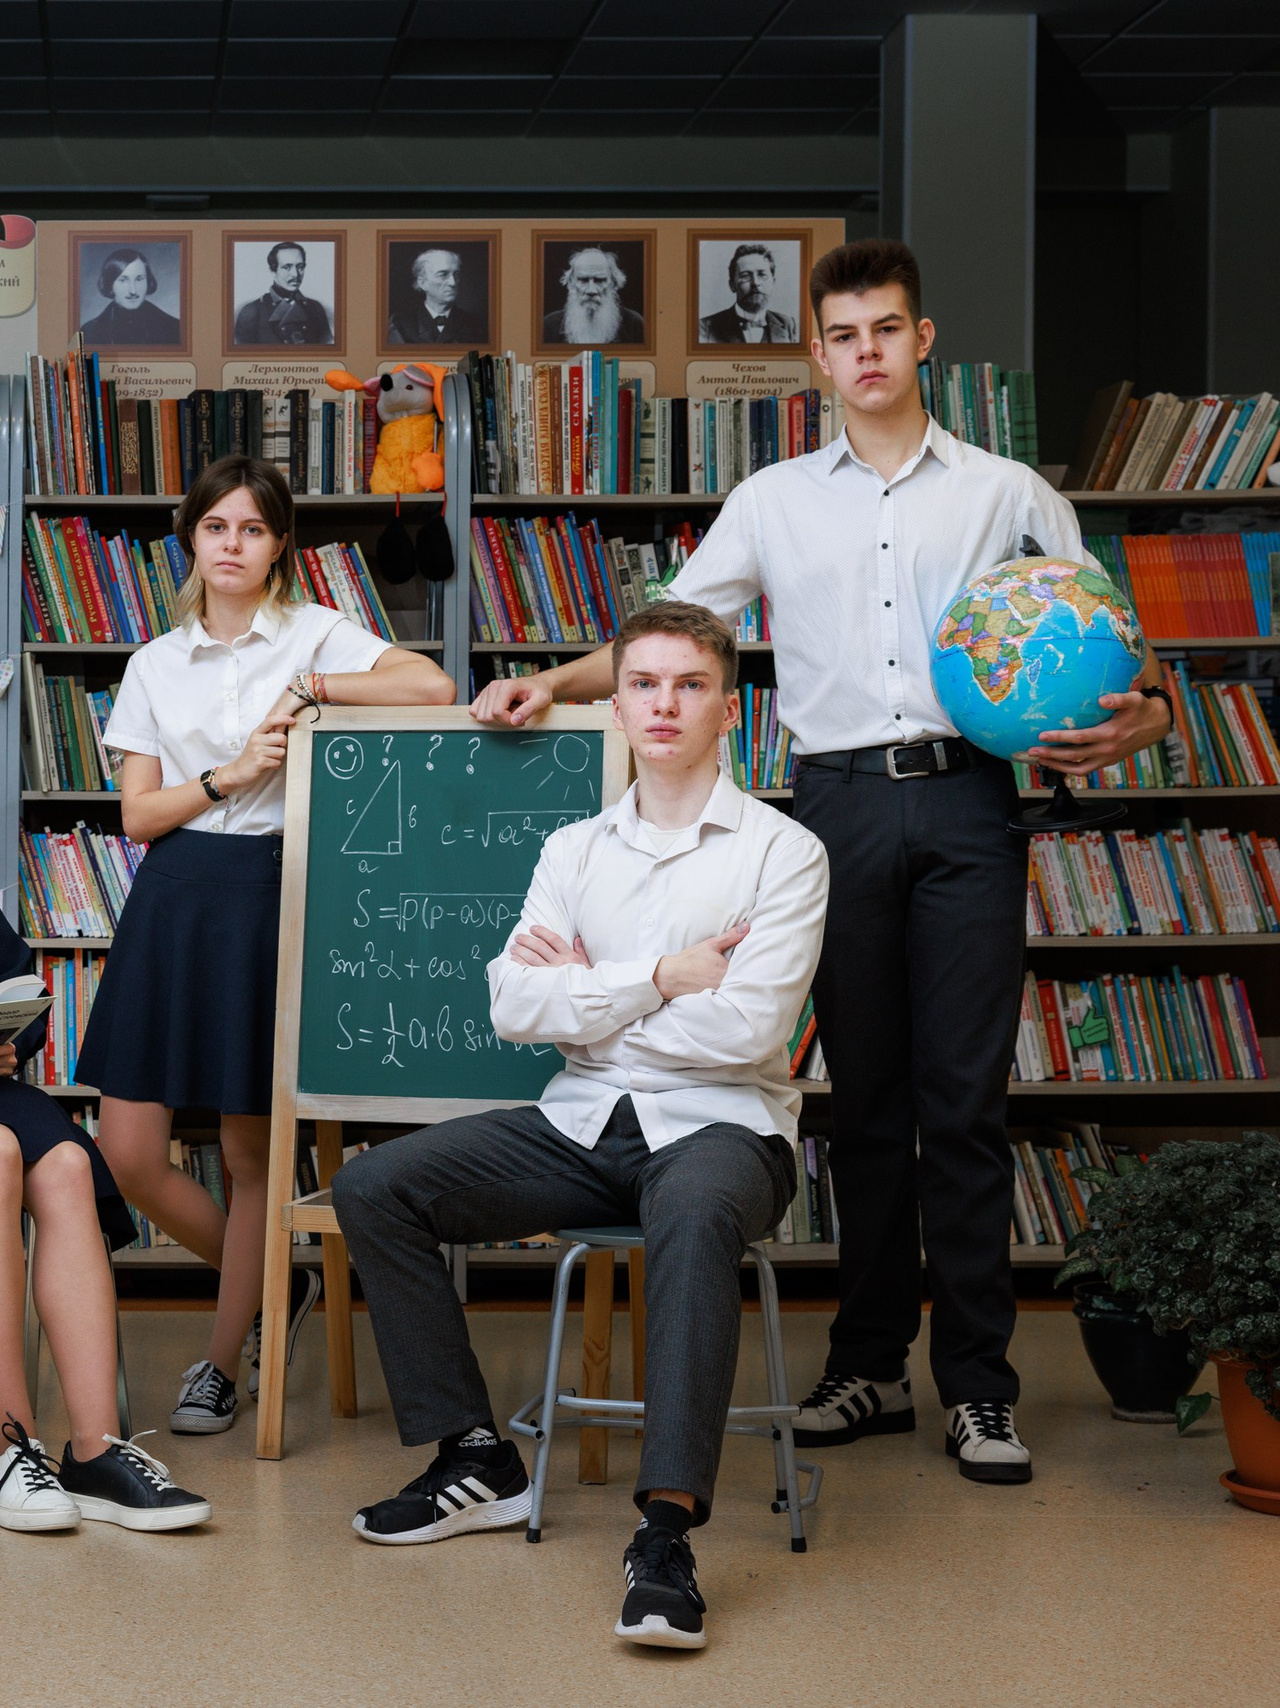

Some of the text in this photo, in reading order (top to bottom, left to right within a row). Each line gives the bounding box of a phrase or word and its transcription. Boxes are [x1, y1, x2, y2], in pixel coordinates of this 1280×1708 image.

[110, 364, 151, 375] Гоголь
[248, 364, 319, 375] Лермонтов
[731, 363, 766, 372] Чехов
[124, 376, 192, 386] Васильевич
[233, 375, 280, 385] Михаил
[696, 375, 800, 385] Антон Павлович
[714, 386, 783, 397] (1860-1904)
[572, 376, 580, 427] СКАЗКИ
[538, 368, 551, 483] ЗОЛОТАЯ КНИГА СКАЗОК
[488, 527, 504, 571] СКАЗКИ
[457, 1437, 497, 1448] adidas
